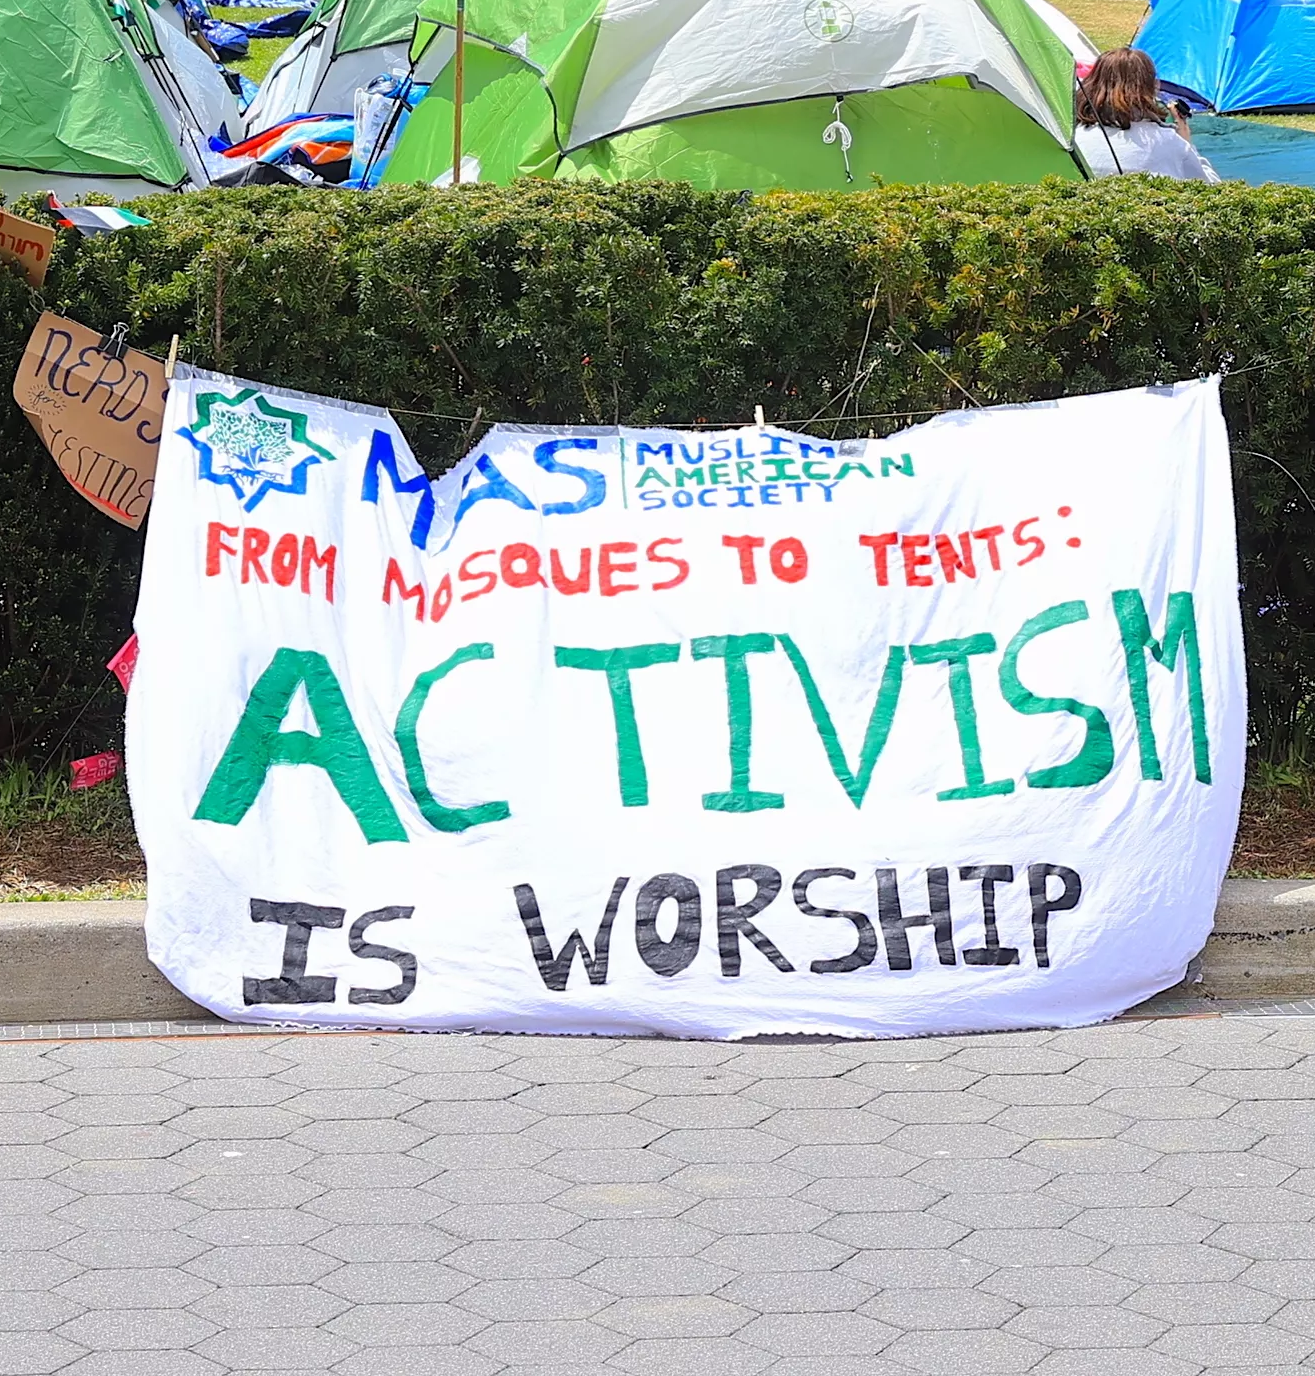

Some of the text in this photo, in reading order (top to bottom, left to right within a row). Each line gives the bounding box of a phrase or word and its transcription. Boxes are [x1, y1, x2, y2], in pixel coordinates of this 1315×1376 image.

[35, 391, 60, 409] for
[636, 434, 837, 465] MUSLIM
[636, 453, 915, 488] AMERICAN
[361, 431, 606, 550] MAS
[638, 481, 838, 511] SOCIETY
[205, 505, 1082, 623] FROM MOSQUES TO TENTS:
[192, 588, 1212, 845] ACTIVISM
[243, 863, 1081, 1005] IS WORSHIP
